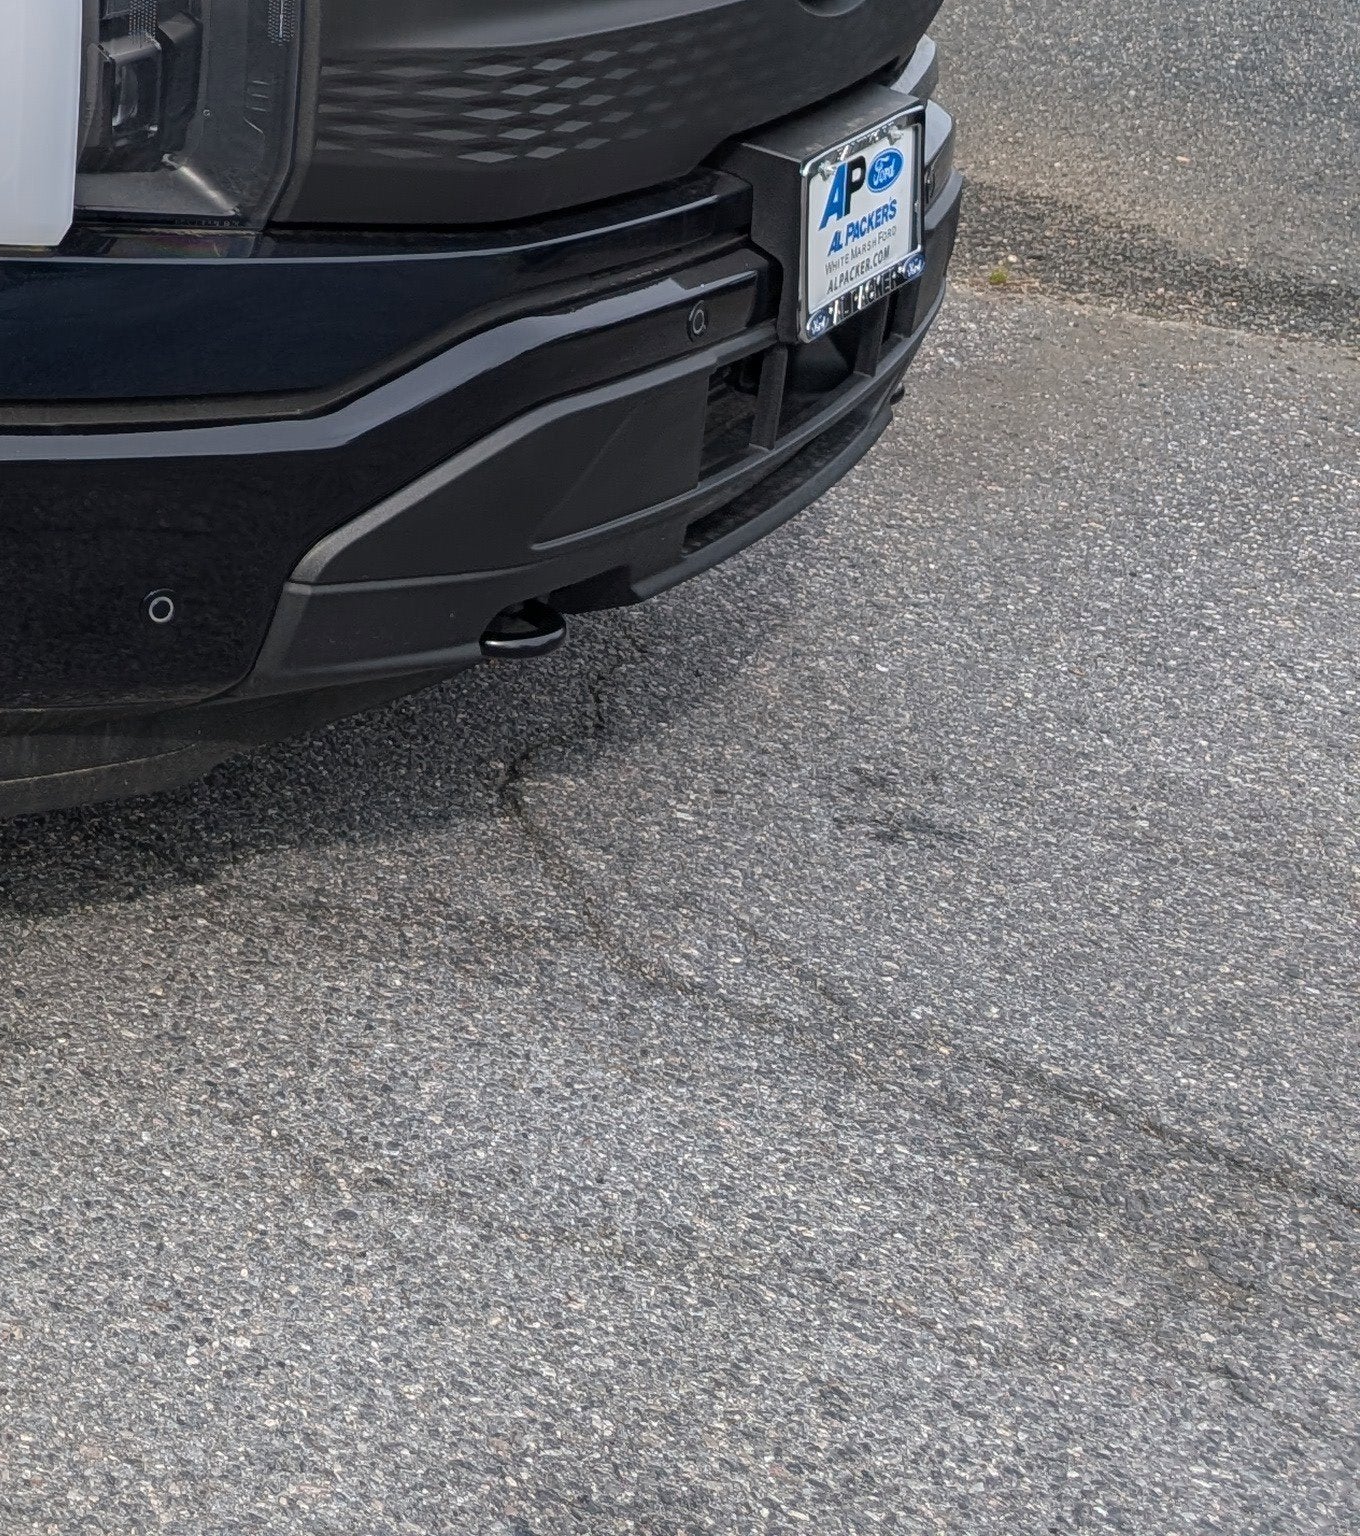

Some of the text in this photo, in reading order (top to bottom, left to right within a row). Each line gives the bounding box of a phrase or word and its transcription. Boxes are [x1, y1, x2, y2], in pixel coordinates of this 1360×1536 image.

[818, 155, 867, 231] AP
[872, 155, 896, 186] Ford
[827, 197, 898, 257] AL PACKER'S
[826, 244, 891, 296] ALPACKER.COM
